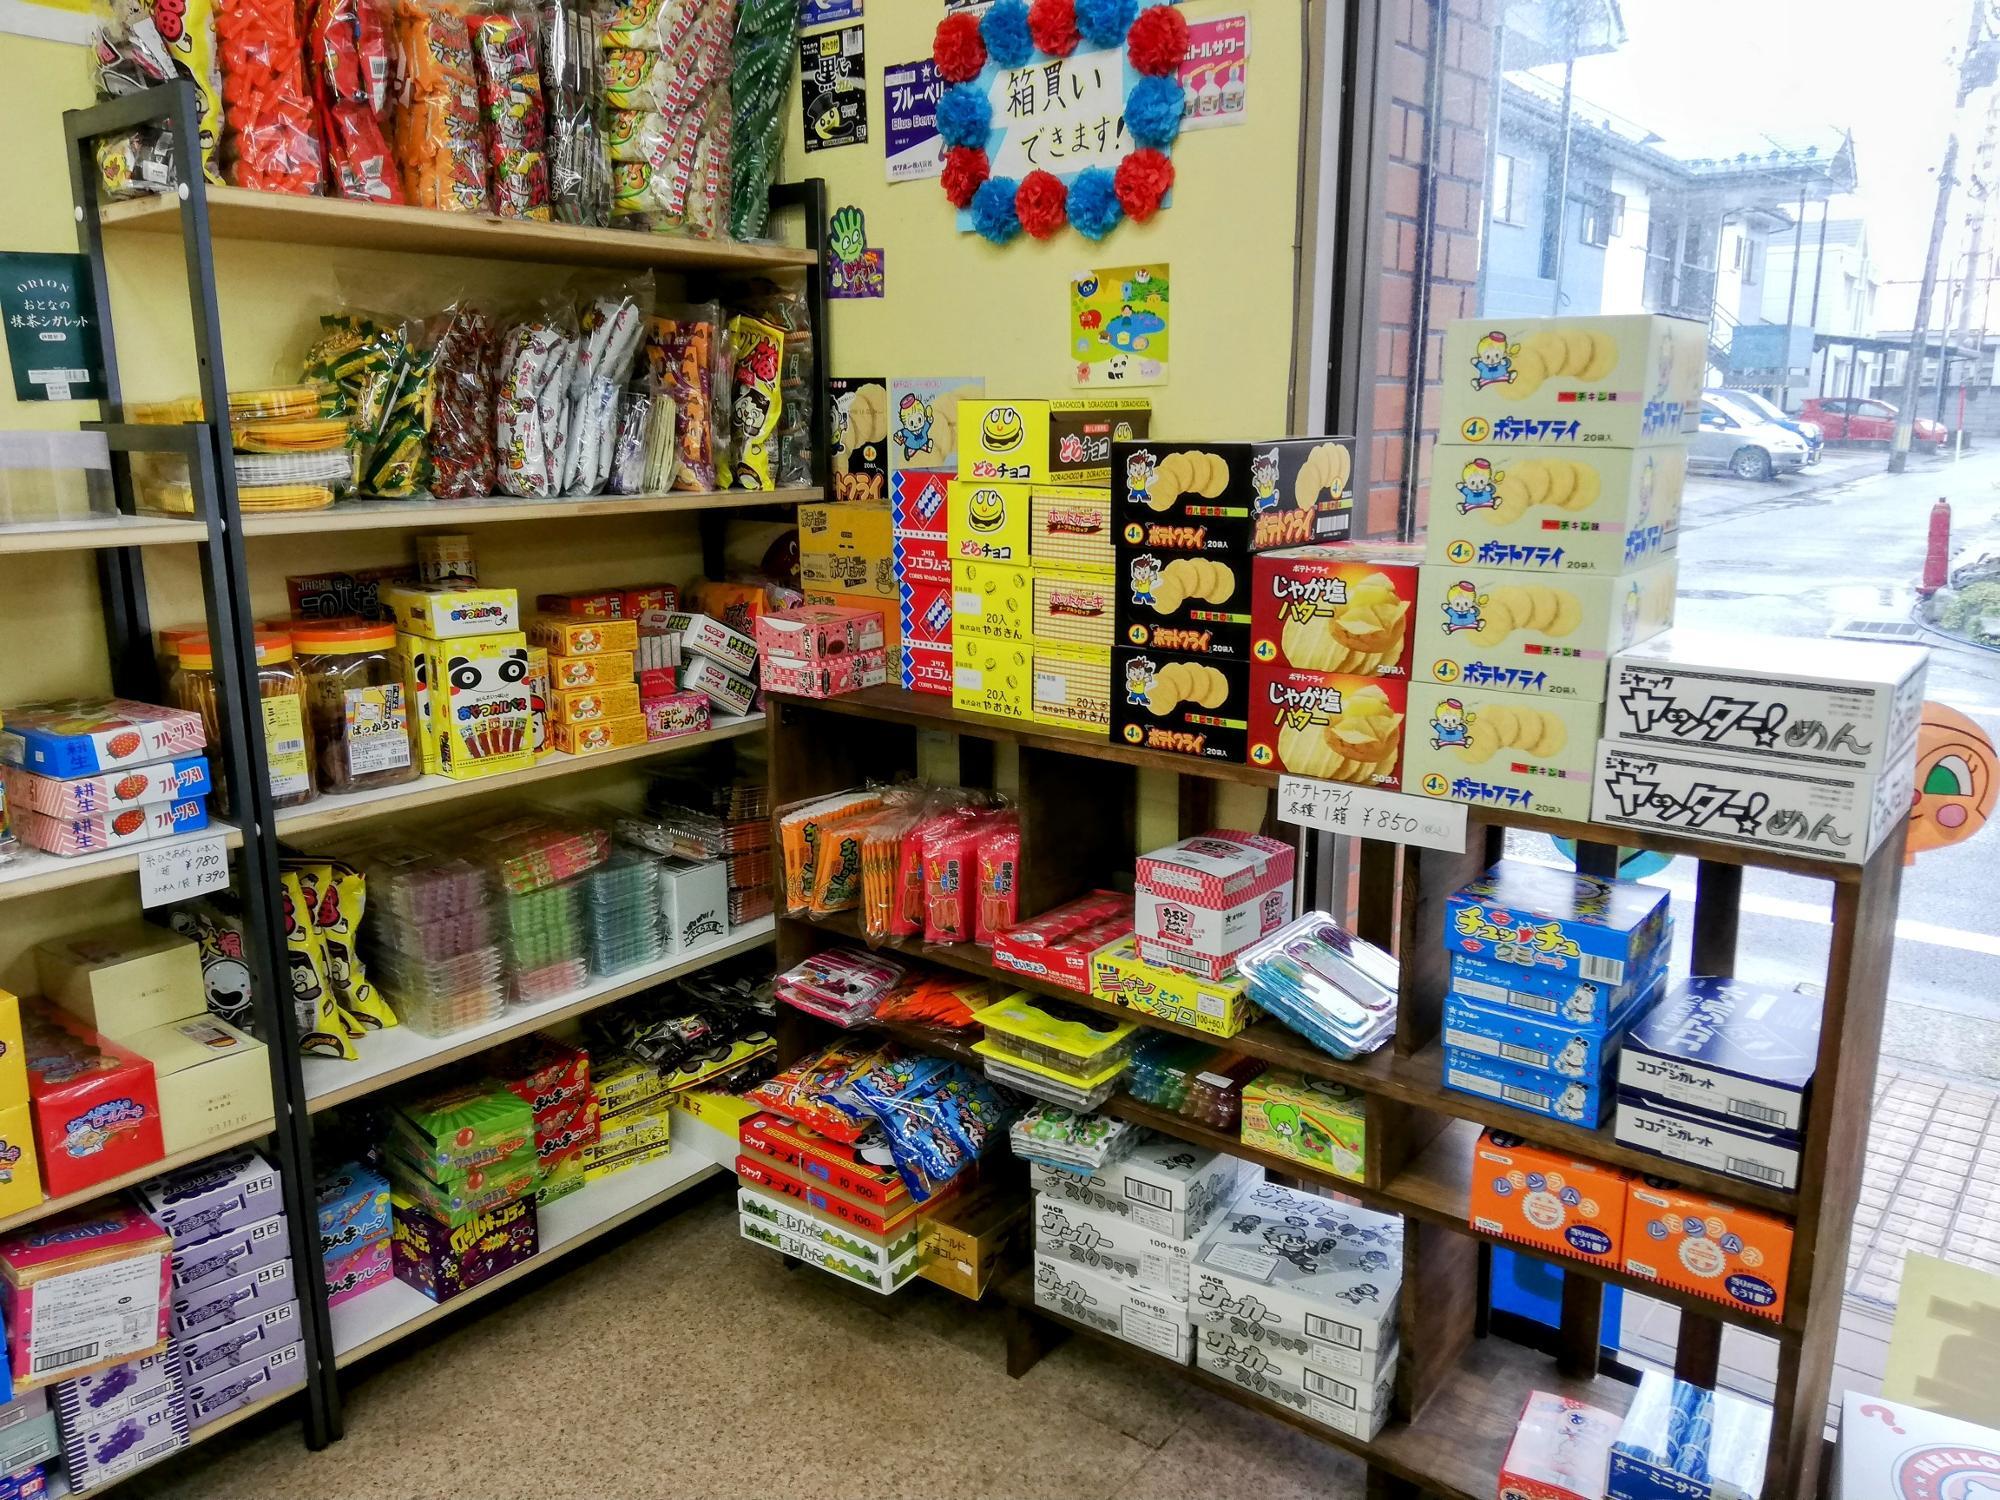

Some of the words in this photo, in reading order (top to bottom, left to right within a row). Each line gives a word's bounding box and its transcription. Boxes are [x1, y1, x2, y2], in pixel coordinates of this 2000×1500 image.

[1007, 60, 1101, 117] 箱買い
[892, 117, 912, 130] Blue
[1021, 115, 1124, 164] できます!
[17, 279, 70, 293] ORION
[24, 299, 70, 311] おとなの
[10, 313, 88, 328] 抹茶シガレット
[1492, 416, 1581, 442] ポテトフライ
[1060, 434, 1110, 462] どらチョコ
[972, 460, 1030, 478] どらチョコ
[1049, 507, 1102, 526] ホットケーキ
[1148, 525, 1205, 549] ポテトフライ
[960, 540, 1011, 559] どらチョコ
[1478, 540, 1565, 568] ポテトフライ
[1292, 565, 1329, 574] ポテトフライ
[1050, 589, 1104, 608] ホットケーキ
[1272, 575, 1346, 603] じゃが塩
[450, 606, 502, 621] おやつカルパス
[986, 613, 1007, 625] 20入
[1278, 600, 1334, 624] バター
[983, 625, 1022, 639] やおきん
[1153, 627, 1210, 652] ポテトフライ
[1288, 673, 1325, 683] ポテトフライ
[1377, 664, 1405, 675] 20袋入
[1463, 661, 1548, 691] ポテトフライ
[1620, 672, 1674, 689] ジャック
[986, 689, 1007, 701] 20入
[1076, 698, 1096, 708] 20入
[1269, 682, 1341, 712] じゃが塩
[458, 698, 527, 720] おやつカルパス
[983, 700, 1022, 715] やおきん
[1067, 707, 1109, 723] やおきん
[661, 715, 694, 729] ほしうめ
[1274, 708, 1329, 730] バター
[152, 721, 196, 749] フルーツ引
[1148, 726, 1204, 754] ポテトフライ
[1606, 757, 1658, 775] ジャック
[159, 767, 203, 793] フルーツ引
[1283, 782, 1353, 805] ポテトフライ
[1451, 777, 1534, 807] ポテトフライ
[155, 802, 199, 828] フルーツ引
[1288, 802, 1318, 819] 各種
[1363, 808, 1418, 832] ¥850
[185, 855, 219, 870] ¥780
[197, 870, 225, 886] ¥390
[1636, 1061, 1714, 1089] ココアシガレット
[1635, 1117, 1713, 1147] ココアシガレット
[1043, 1204, 1063, 1214] JACK
[1041, 1212, 1114, 1249] サッカー
[1039, 1260, 1056, 1271] JACK
[1069, 1243, 1138, 1278] スクラッチ
[1038, 1268, 1097, 1305] サッカー
[1201, 1274, 1223, 1285] JACK
[1198, 1282, 1282, 1324] サッカー
[1230, 1317, 1308, 1355] スクラッチ
[1206, 1331, 1282, 1375] サッカー
